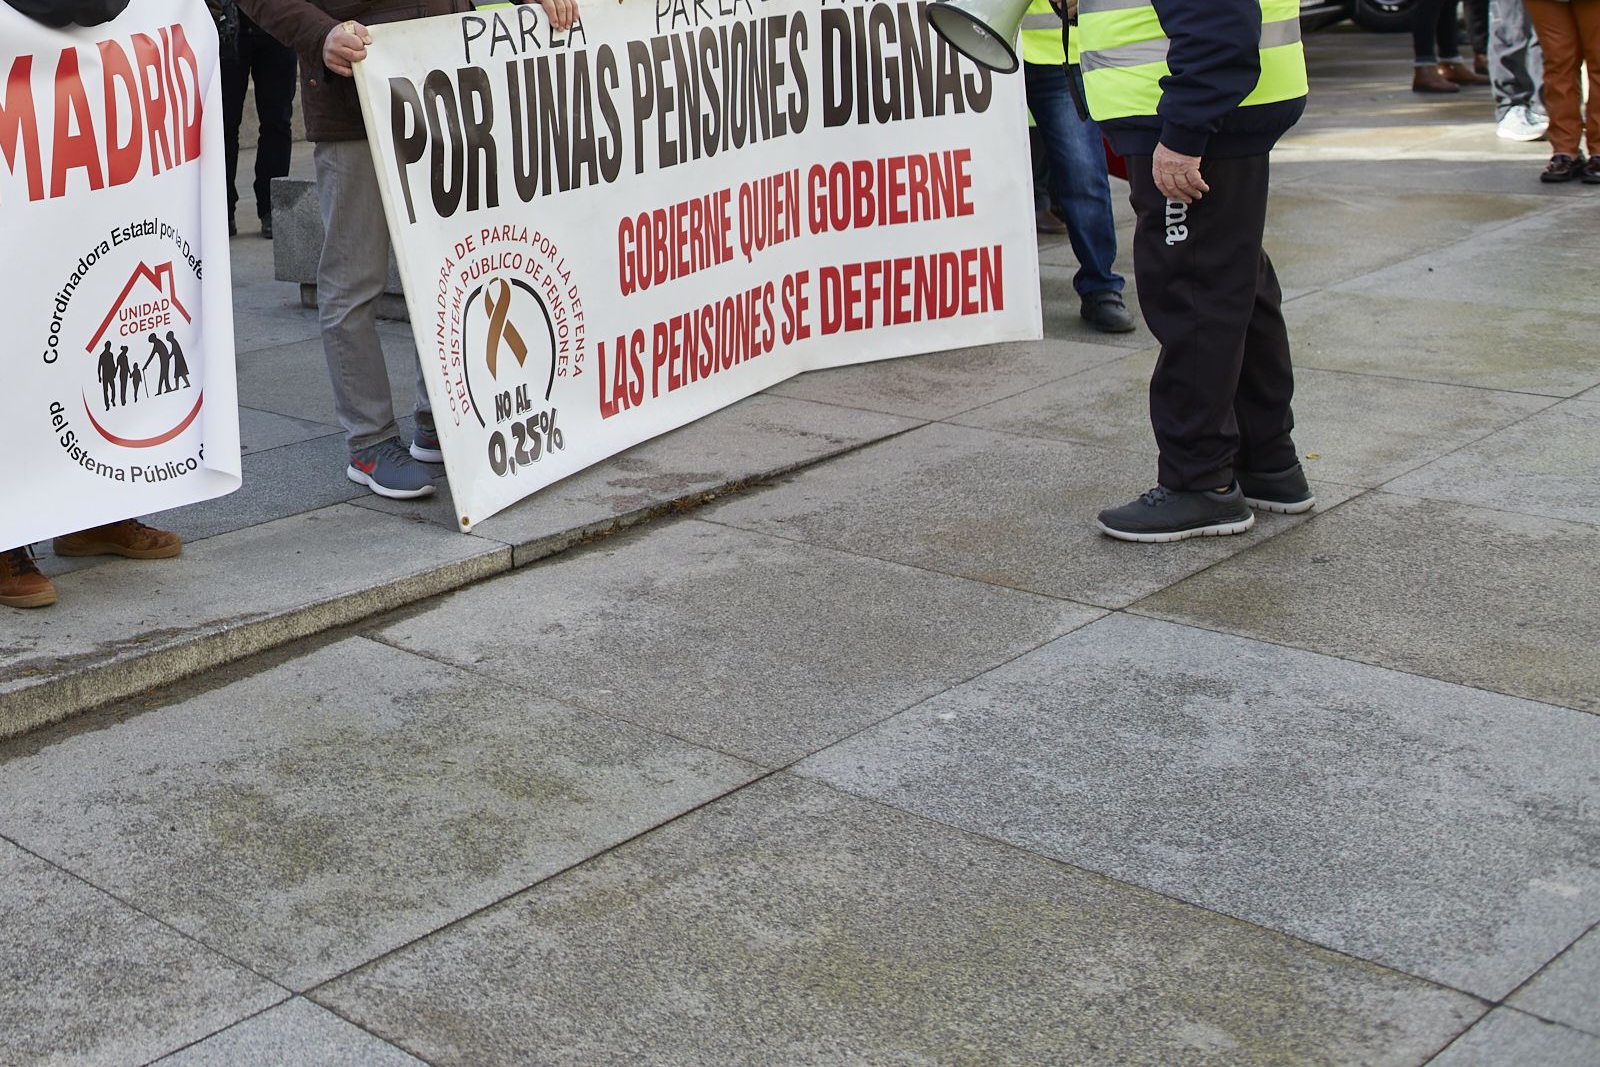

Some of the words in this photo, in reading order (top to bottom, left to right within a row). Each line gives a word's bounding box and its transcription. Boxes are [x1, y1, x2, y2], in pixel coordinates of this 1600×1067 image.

[389, 66, 499, 224] POR
[506, 44, 623, 203] UNAS
[627, 10, 809, 175] PENSIONES
[618, 187, 733, 297] GOBIERNE
[738, 168, 800, 263] QUIEN
[807, 148, 975, 235] GOBIERNE
[43, 240, 110, 364] Coordinadora
[110, 217, 158, 246] Estatal
[160, 222, 175, 240] por
[119, 298, 170, 322] UNIDAD
[460, 252, 522, 288] PÚBLICO
[525, 258, 544, 281] DE
[119, 312, 171, 337] COESPE
[437, 257, 460, 427] COORDINADORA
[455, 235, 476, 260] DE
[481, 225, 528, 246] PARLA
[532, 231, 557, 263] POR
[556, 258, 571, 285] LA
[568, 285, 585, 378] DEFENSA
[451, 285, 464, 367] SISTEMA
[541, 275, 569, 377] PENSIONES
[598, 328, 646, 420] LAS
[652, 280, 775, 399] PENSIONES
[781, 270, 811, 346] SE
[819, 244, 1004, 336] DEFIENDEN
[455, 373, 471, 414] DEL
[494, 390, 512, 424] NO
[515, 383, 533, 415] AL
[49, 401, 69, 433] del
[60, 429, 125, 482] Sistema
[130, 457, 198, 483] Público
[488, 407, 566, 478] 0,25%
